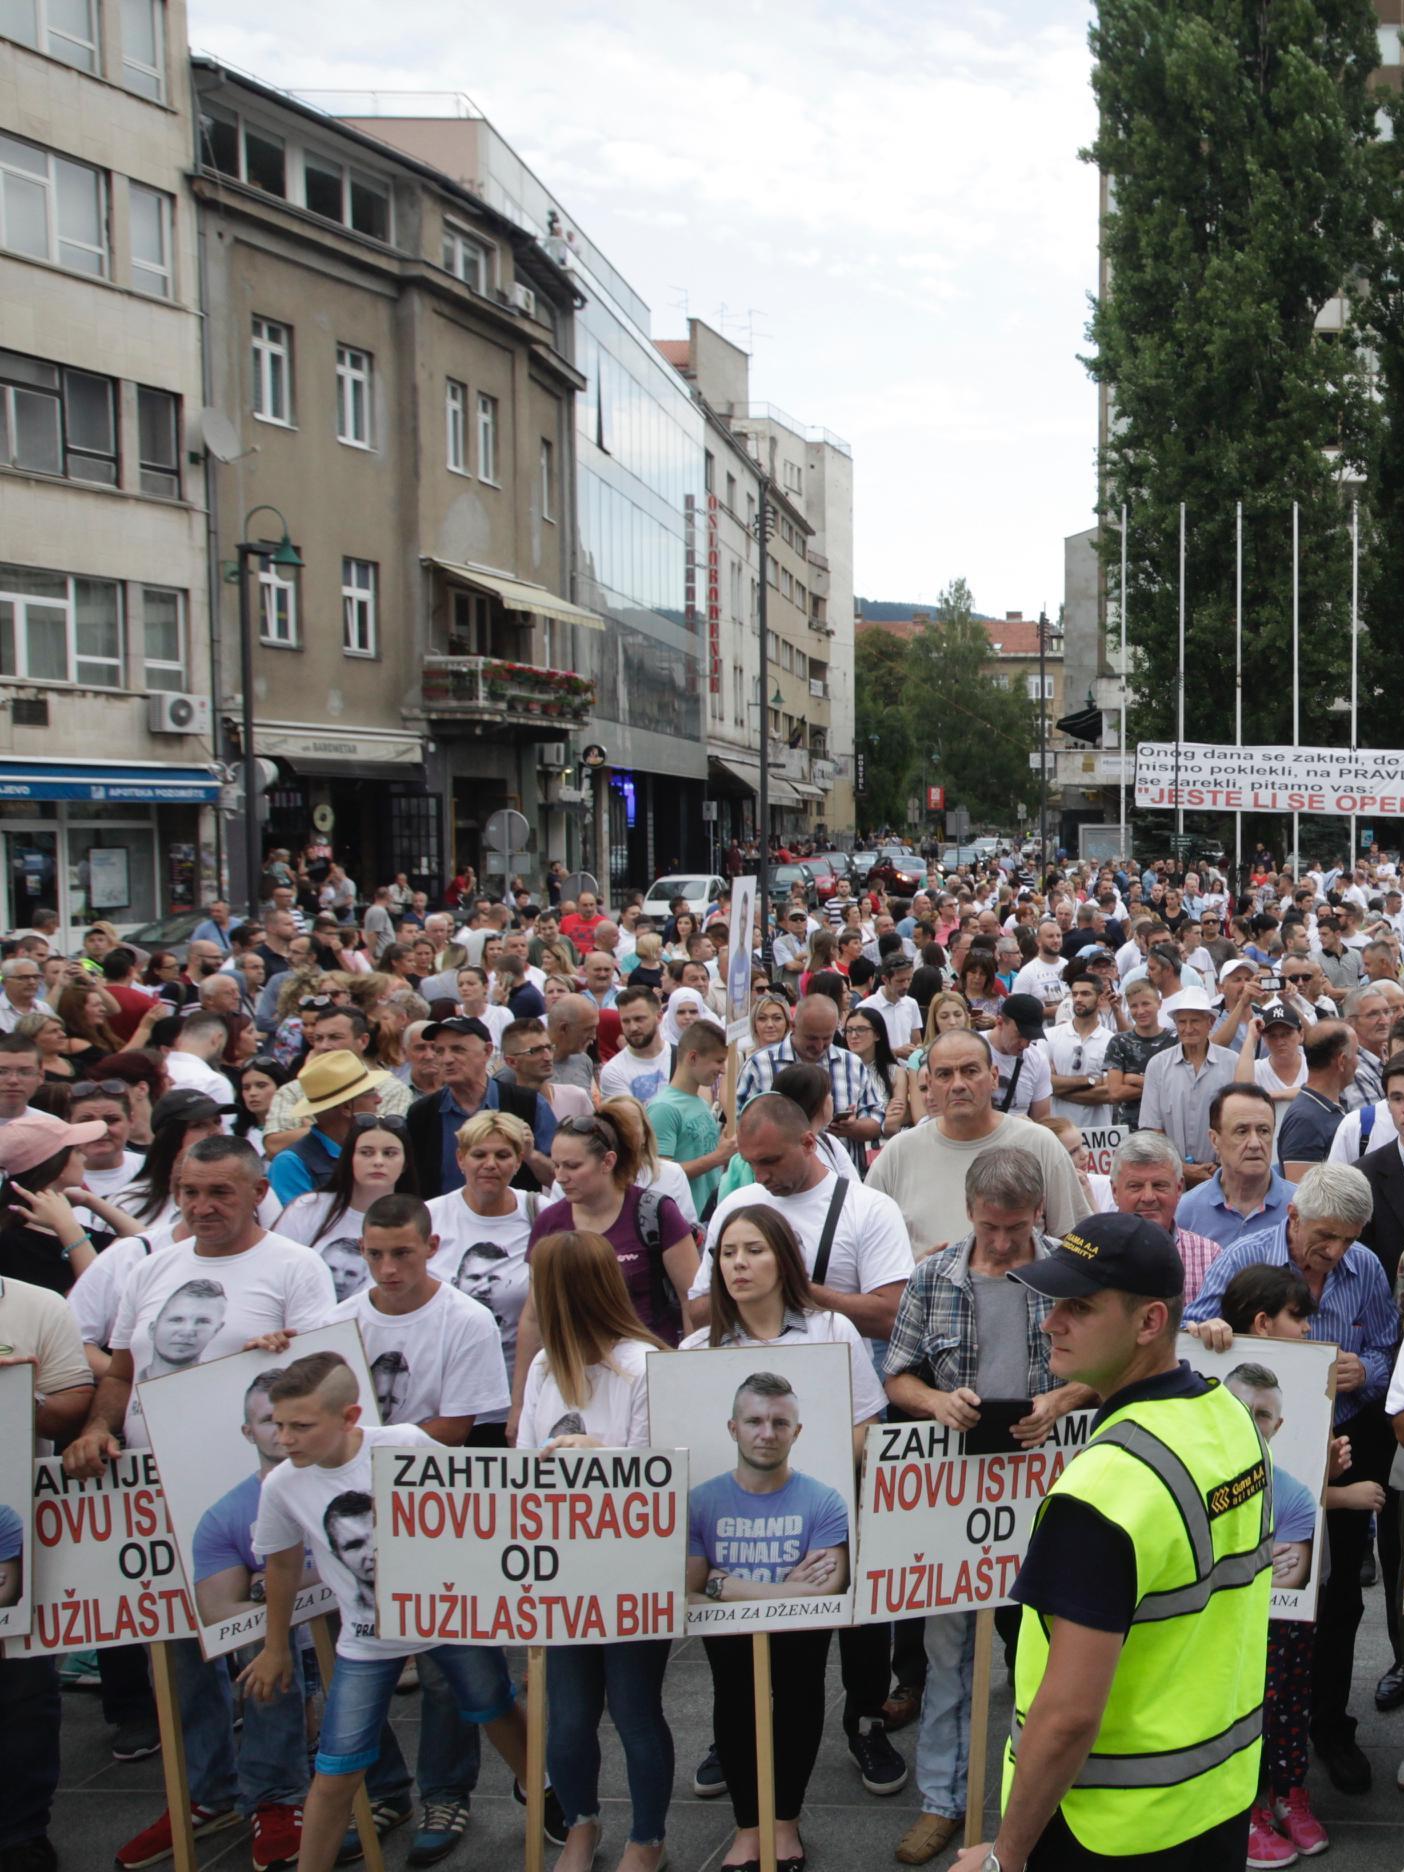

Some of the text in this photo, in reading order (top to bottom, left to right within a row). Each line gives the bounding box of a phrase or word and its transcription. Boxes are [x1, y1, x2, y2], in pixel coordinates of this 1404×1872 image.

[1139, 746, 1195, 761] Onog
[1203, 748, 1254, 761] dana
[1261, 752, 1286, 762] se
[1373, 756, 1400, 766] do
[1139, 761, 1203, 773] nismo
[1210, 763, 1298, 778] poklekli,
[1305, 768, 1331, 778] na
[1137, 787, 1243, 808] "JESTE
[1253, 791, 1278, 809] LI
[1287, 793, 1325, 810] SE
[1138, 777, 1161, 786] se
[1250, 780, 1323, 793] pitamo
[1330, 782, 1374, 794] vas:
[1082, 1131, 1121, 1149] AMO
[393, 1454, 672, 1489] ZAHTIJEVAMO
[873, 1449, 1082, 1514] NOVU ISTRA
[36, 1494, 112, 1547] OVU
[391, 1491, 676, 1540] NOVU ISTRAGU
[715, 1515, 803, 1539] GRAND
[966, 1505, 1016, 1545] OD
[119, 1540, 175, 1580] OD
[501, 1544, 560, 1582] OD
[714, 1540, 800, 1563] FINALS
[24, 1580, 198, 1650] UŽILAŠTV
[219, 1612, 266, 1640] PRAV
[294, 1594, 316, 1611] ZA
[391, 1582, 674, 1640] TUŽILAŠTVA BIH
[688, 1601, 841, 1623] RAVDA ZA DŽENANA
